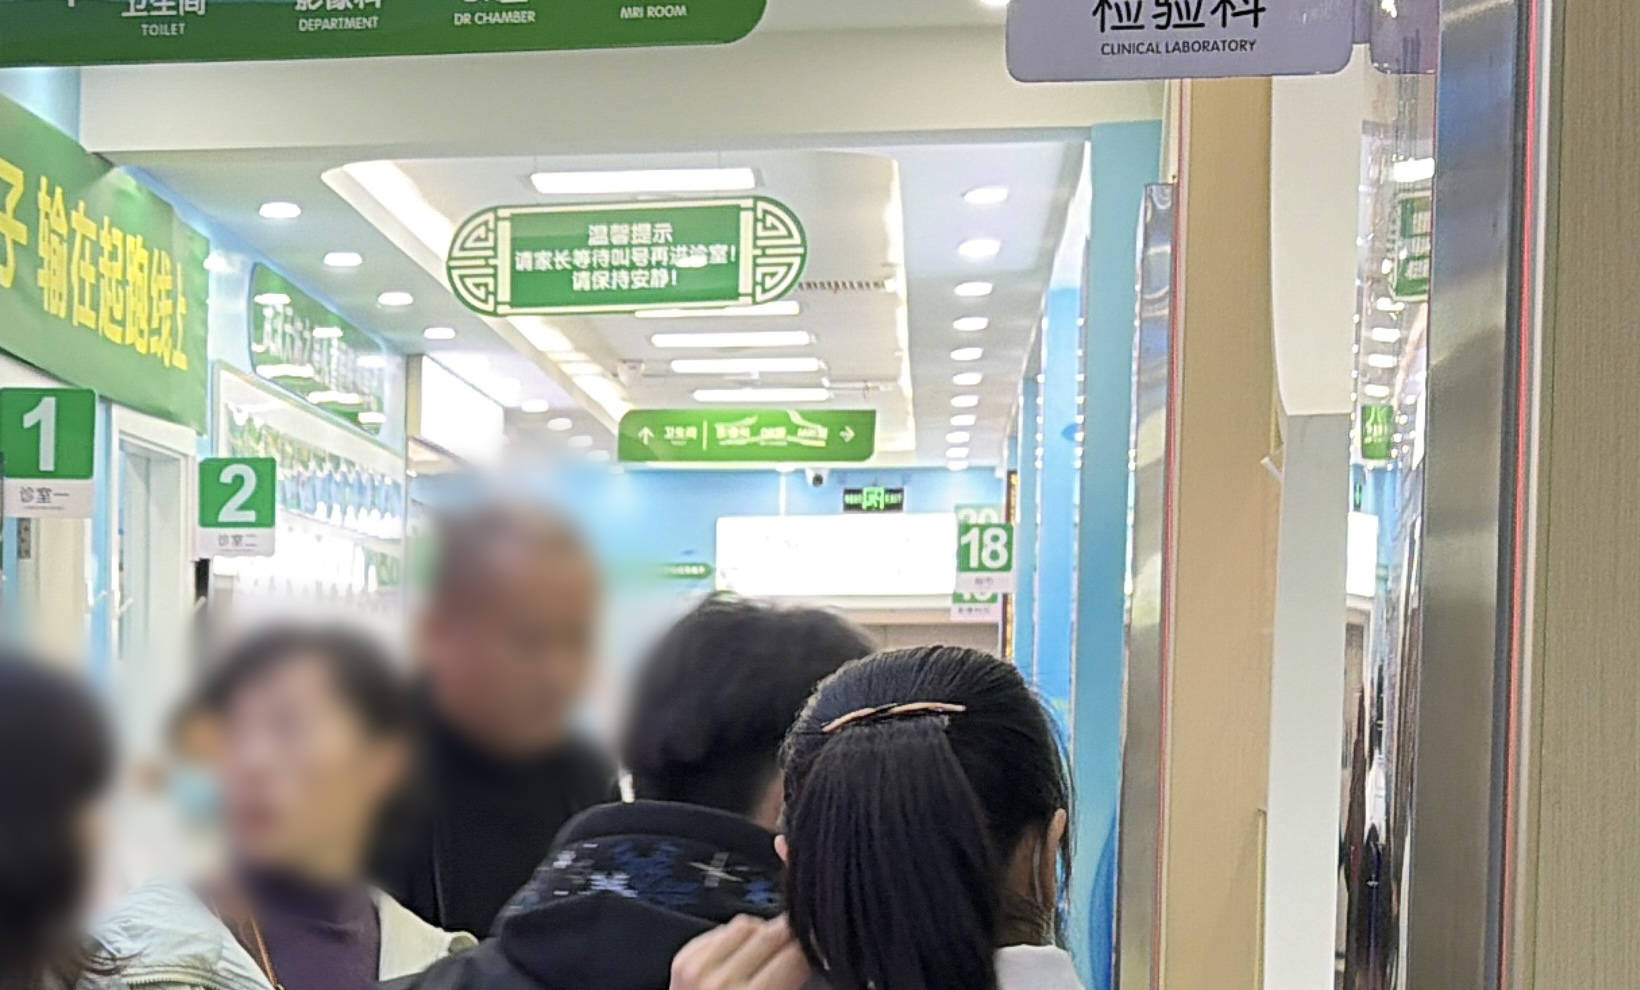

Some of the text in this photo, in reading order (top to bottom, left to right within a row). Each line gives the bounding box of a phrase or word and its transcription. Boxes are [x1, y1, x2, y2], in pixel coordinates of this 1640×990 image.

[454, 10, 536, 26] DR CHAMBER
[620, 5, 687, 20] MRI ROOM
[141, 23, 185, 37] TOILET
[298, 16, 379, 32] DEPARTMENT
[1100, 38, 1257, 56] CLINICAL LABORATORY
[588, 222, 673, 246] 温馨提示
[22, 396, 57, 472] 1
[217, 464, 257, 523] 2
[960, 526, 1009, 569] 18
